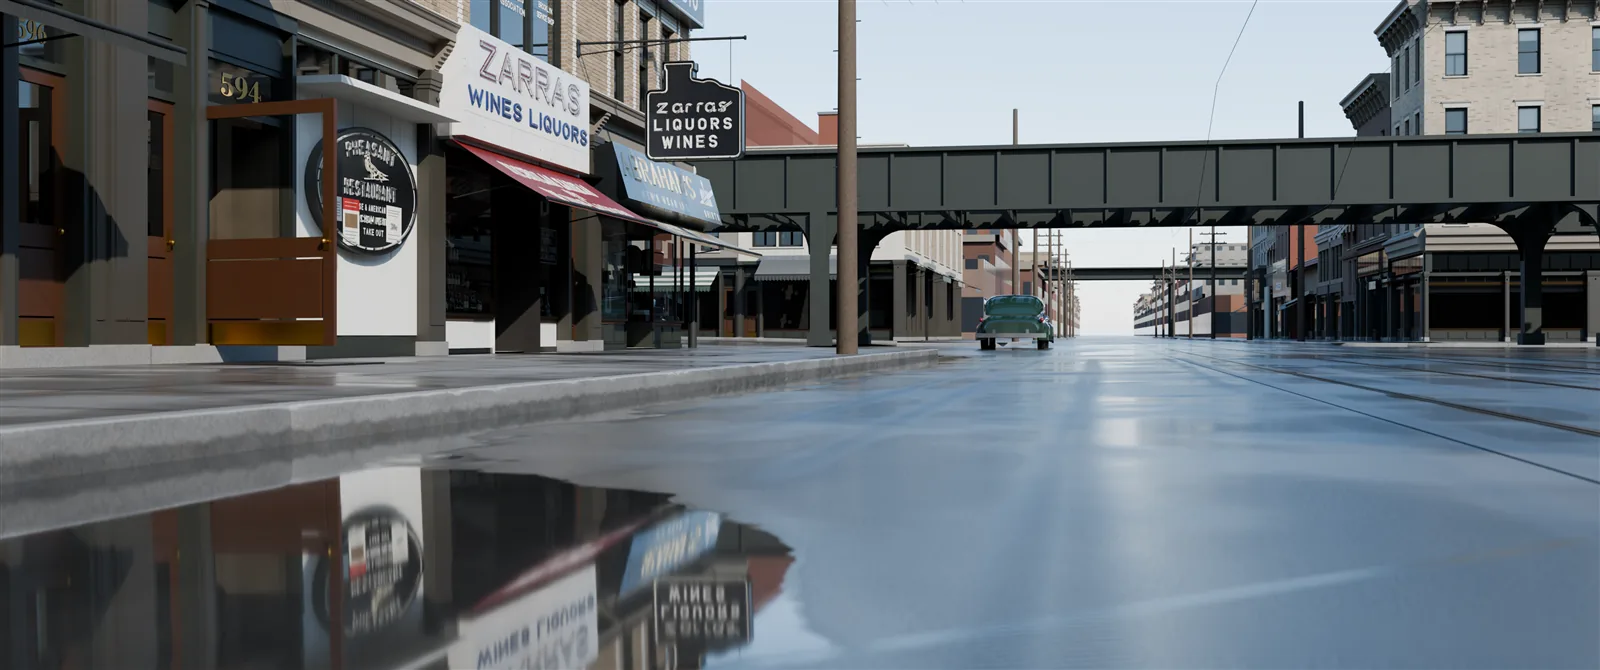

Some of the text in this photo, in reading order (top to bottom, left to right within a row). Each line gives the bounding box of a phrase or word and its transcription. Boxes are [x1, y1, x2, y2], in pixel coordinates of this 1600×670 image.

[220, 72, 262, 104] 594
[479, 40, 580, 117] ZARRAS
[468, 83, 588, 147] WINES LIQUORS
[653, 116, 733, 132] LIQUORS
[344, 139, 397, 167] PHEASANT
[661, 134, 719, 150] WINES
[343, 177, 398, 203] RESTAURANT
[363, 227, 375, 237] TAKE
[375, 229, 385, 238] OUT
